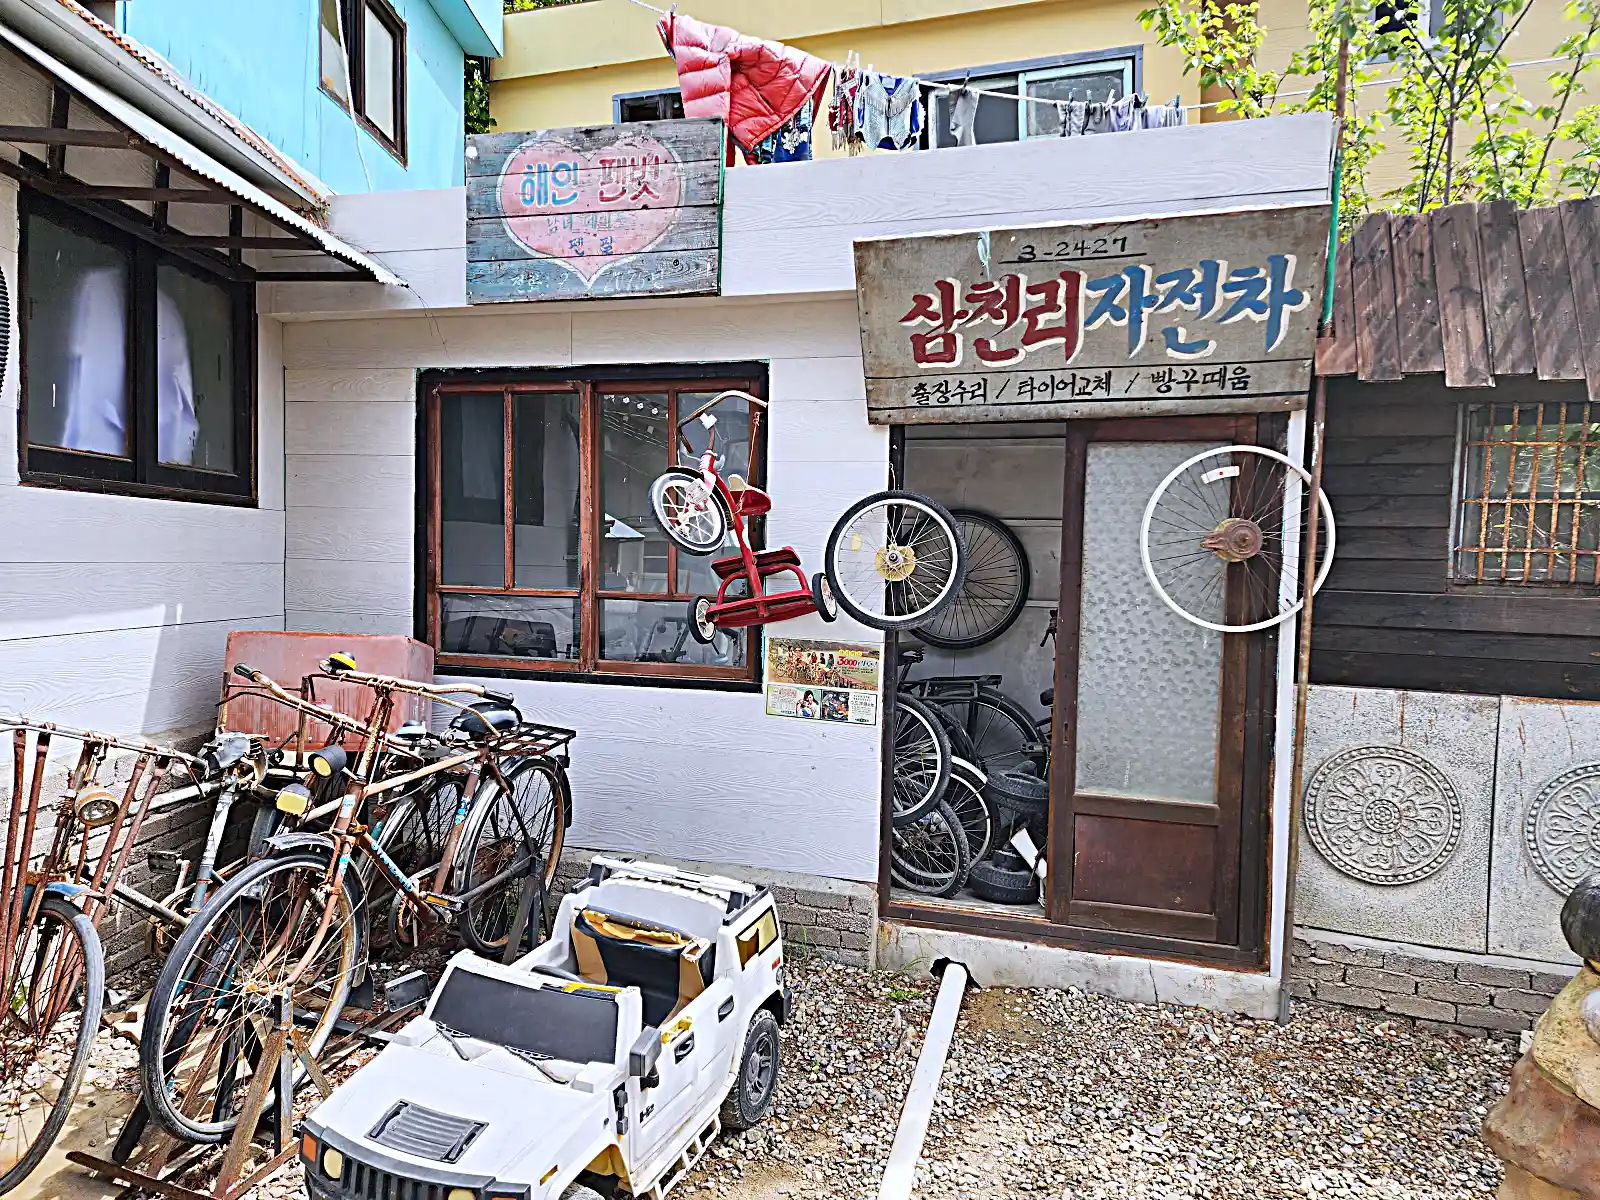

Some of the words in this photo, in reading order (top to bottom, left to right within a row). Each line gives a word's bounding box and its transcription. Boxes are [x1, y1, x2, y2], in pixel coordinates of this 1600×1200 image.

[520, 161, 579, 207] 해인
[1017, 236, 1128, 262] 3-2427
[911, 377, 988, 406] 출장수리
[1016, 370, 1113, 400] 타이어교체
[1150, 365, 1252, 393] 빵꾸때움
